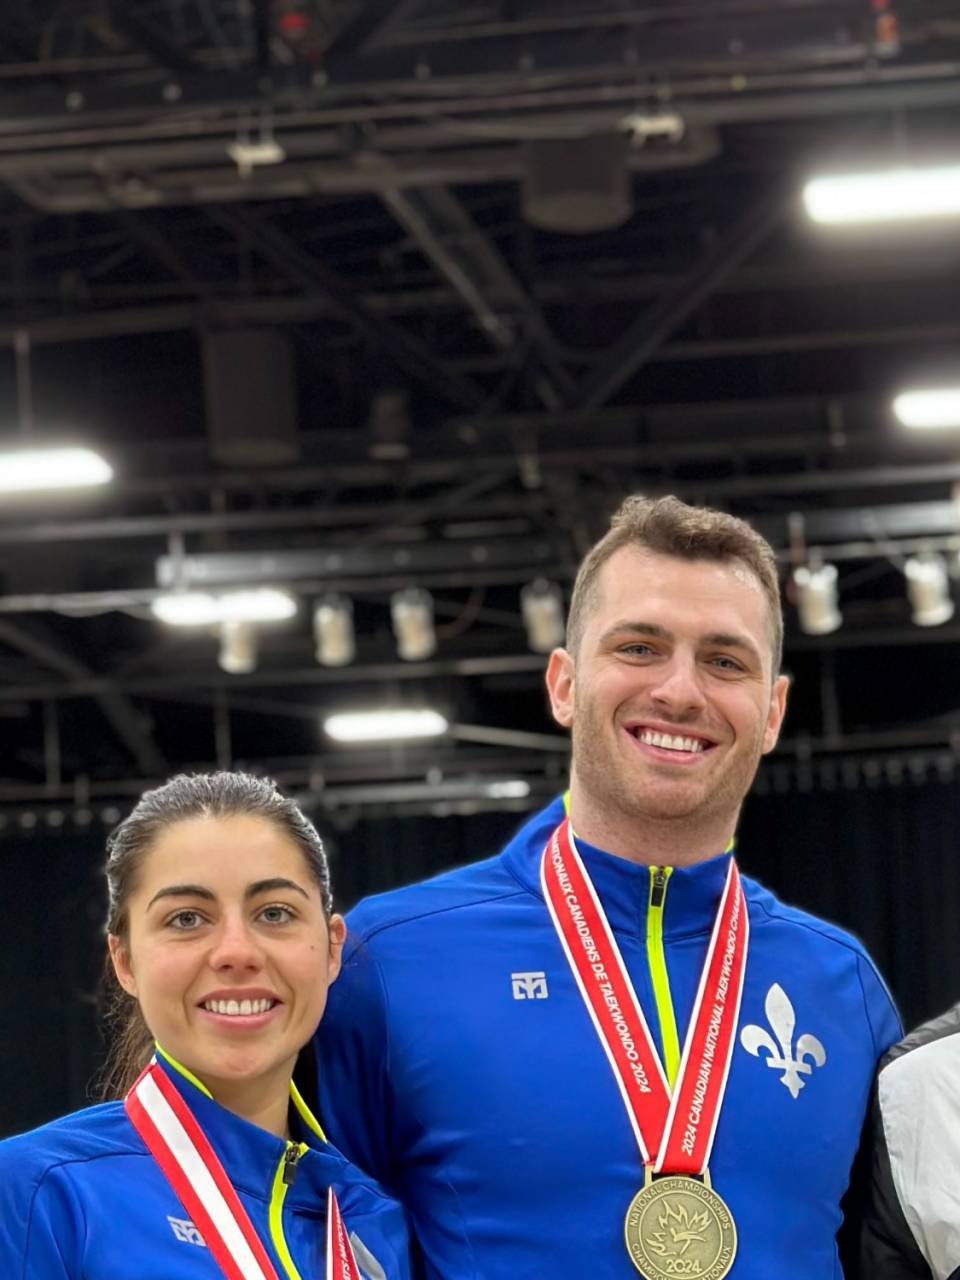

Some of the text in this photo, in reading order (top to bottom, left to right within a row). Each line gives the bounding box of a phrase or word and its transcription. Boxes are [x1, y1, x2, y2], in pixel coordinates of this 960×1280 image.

[566, 894, 602, 963] CANADIENS
[591, 961, 609, 981] DE
[601, 982, 639, 1061] TAEKWONDO
[630, 1061, 652, 1094] 2024
[716, 931, 738, 1003] TAEKWONDO
[703, 1004, 725, 1064] NATIONAL
[688, 1060, 714, 1126] CANADIAN
[681, 1124, 698, 1157] 2024
[629, 1181, 732, 1230] NATIONAL CHAMPIONSHIPS
[665, 1259, 702, 1273] 2024
